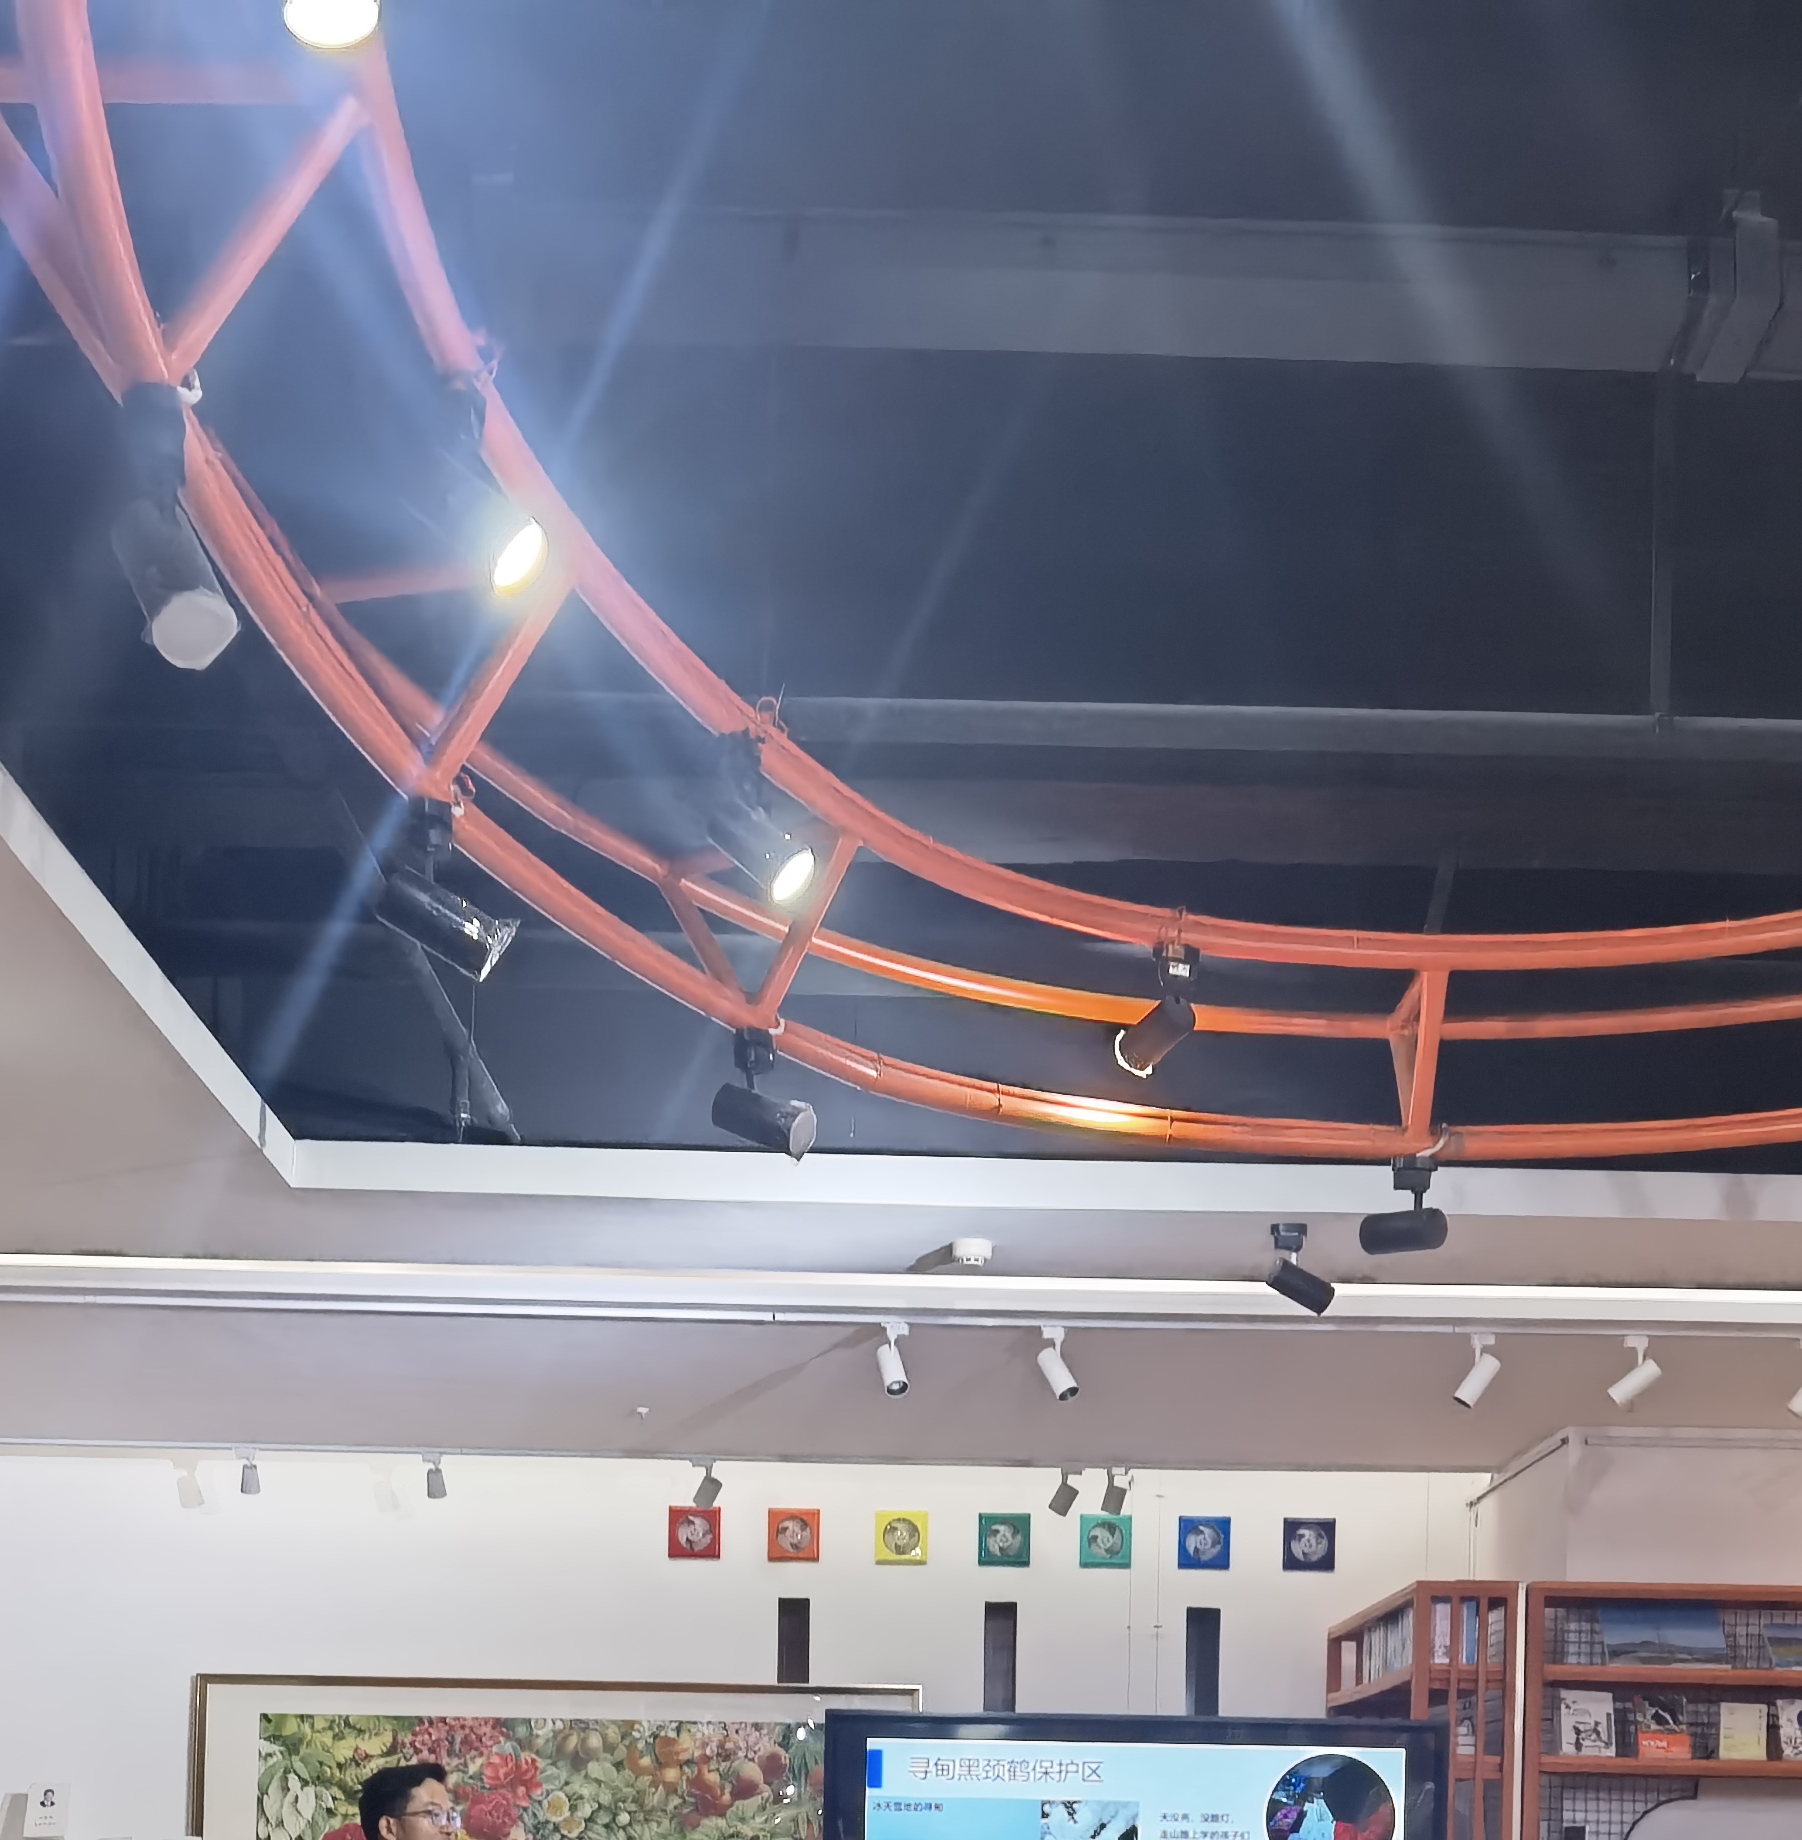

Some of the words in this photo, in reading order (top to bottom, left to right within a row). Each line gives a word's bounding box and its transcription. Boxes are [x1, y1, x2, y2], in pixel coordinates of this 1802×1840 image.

[907, 1756, 1104, 1783] 寻甸黑颈鹤保护区
